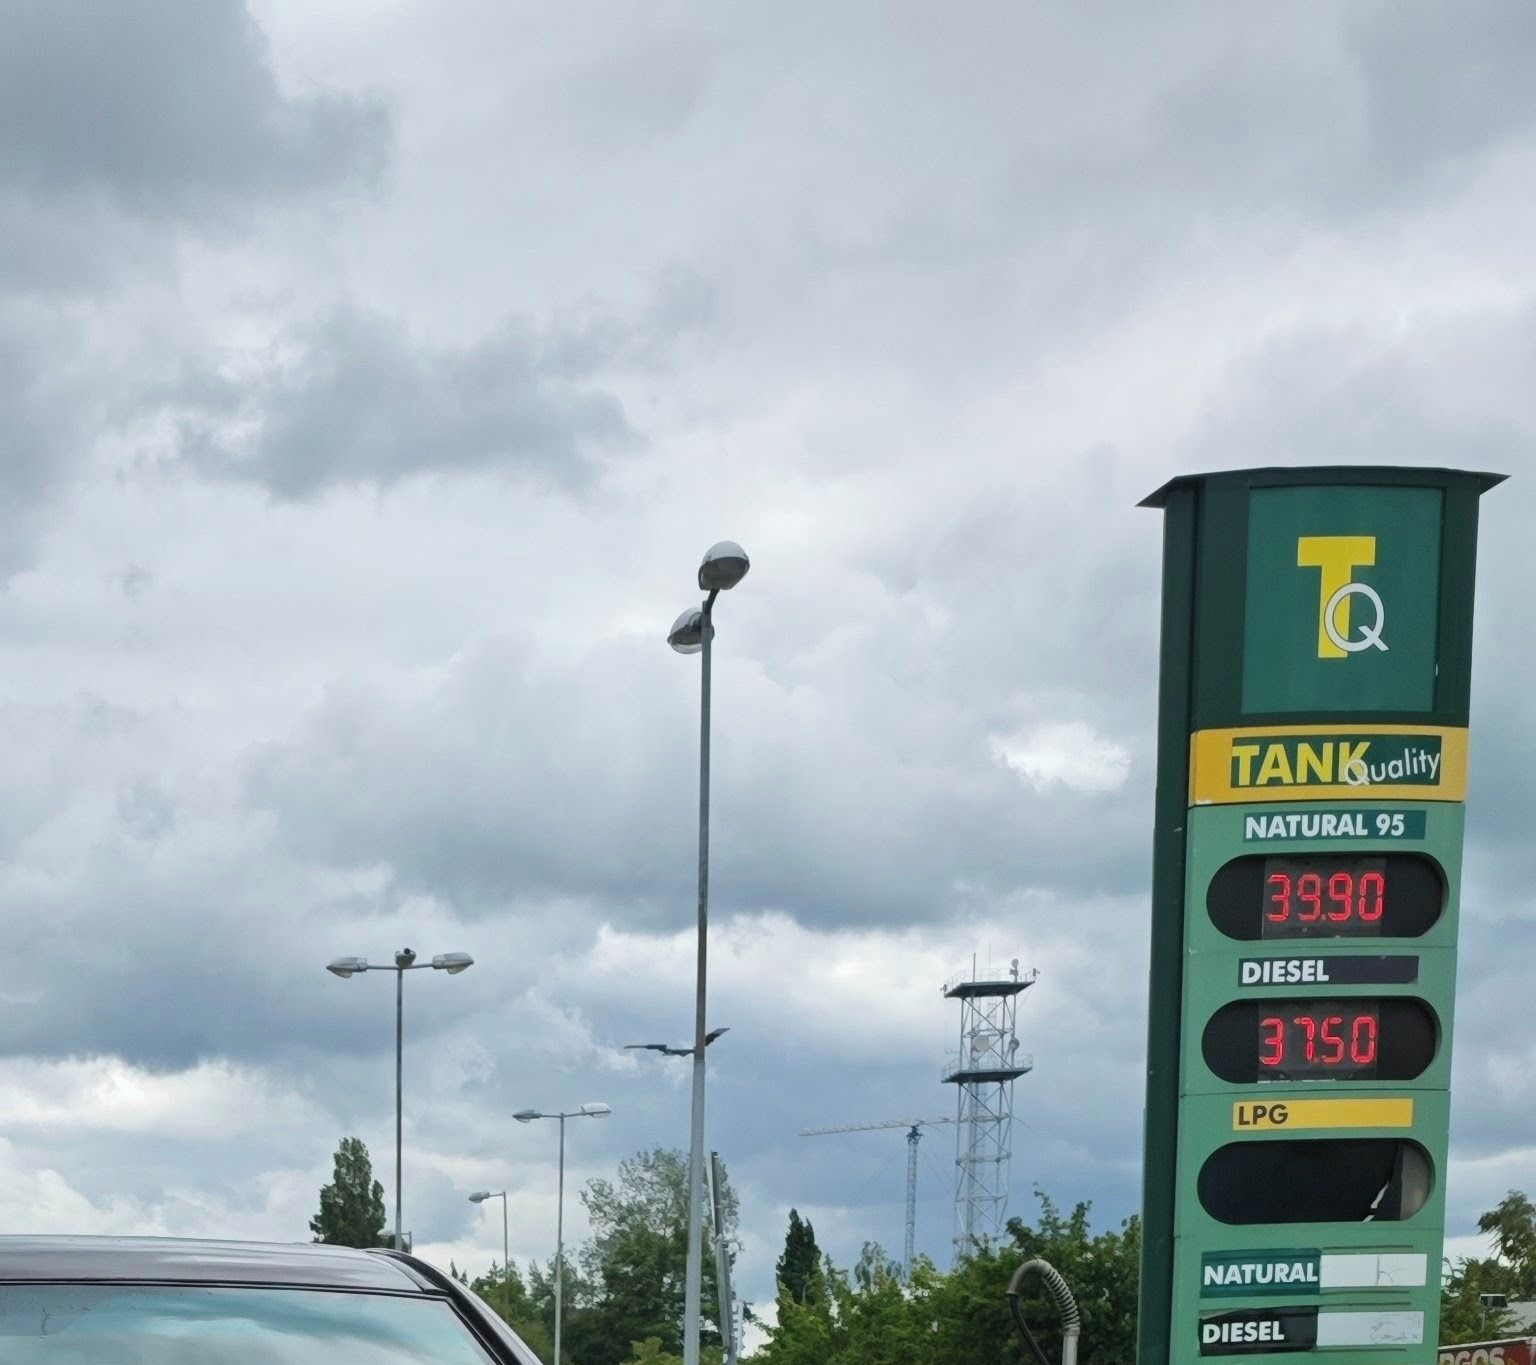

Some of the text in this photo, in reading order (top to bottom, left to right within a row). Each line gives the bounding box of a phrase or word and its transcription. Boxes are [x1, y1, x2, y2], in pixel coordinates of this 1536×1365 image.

[1232, 741, 1441, 786] TANK Quality
[1245, 813, 1406, 839] NATURAL 95
[1241, 959, 1330, 984] DIESEL
[1238, 1104, 1289, 1126] LPG
[1204, 1262, 1319, 1286] NATURAL
[1202, 1320, 1285, 1344] DIESEL
